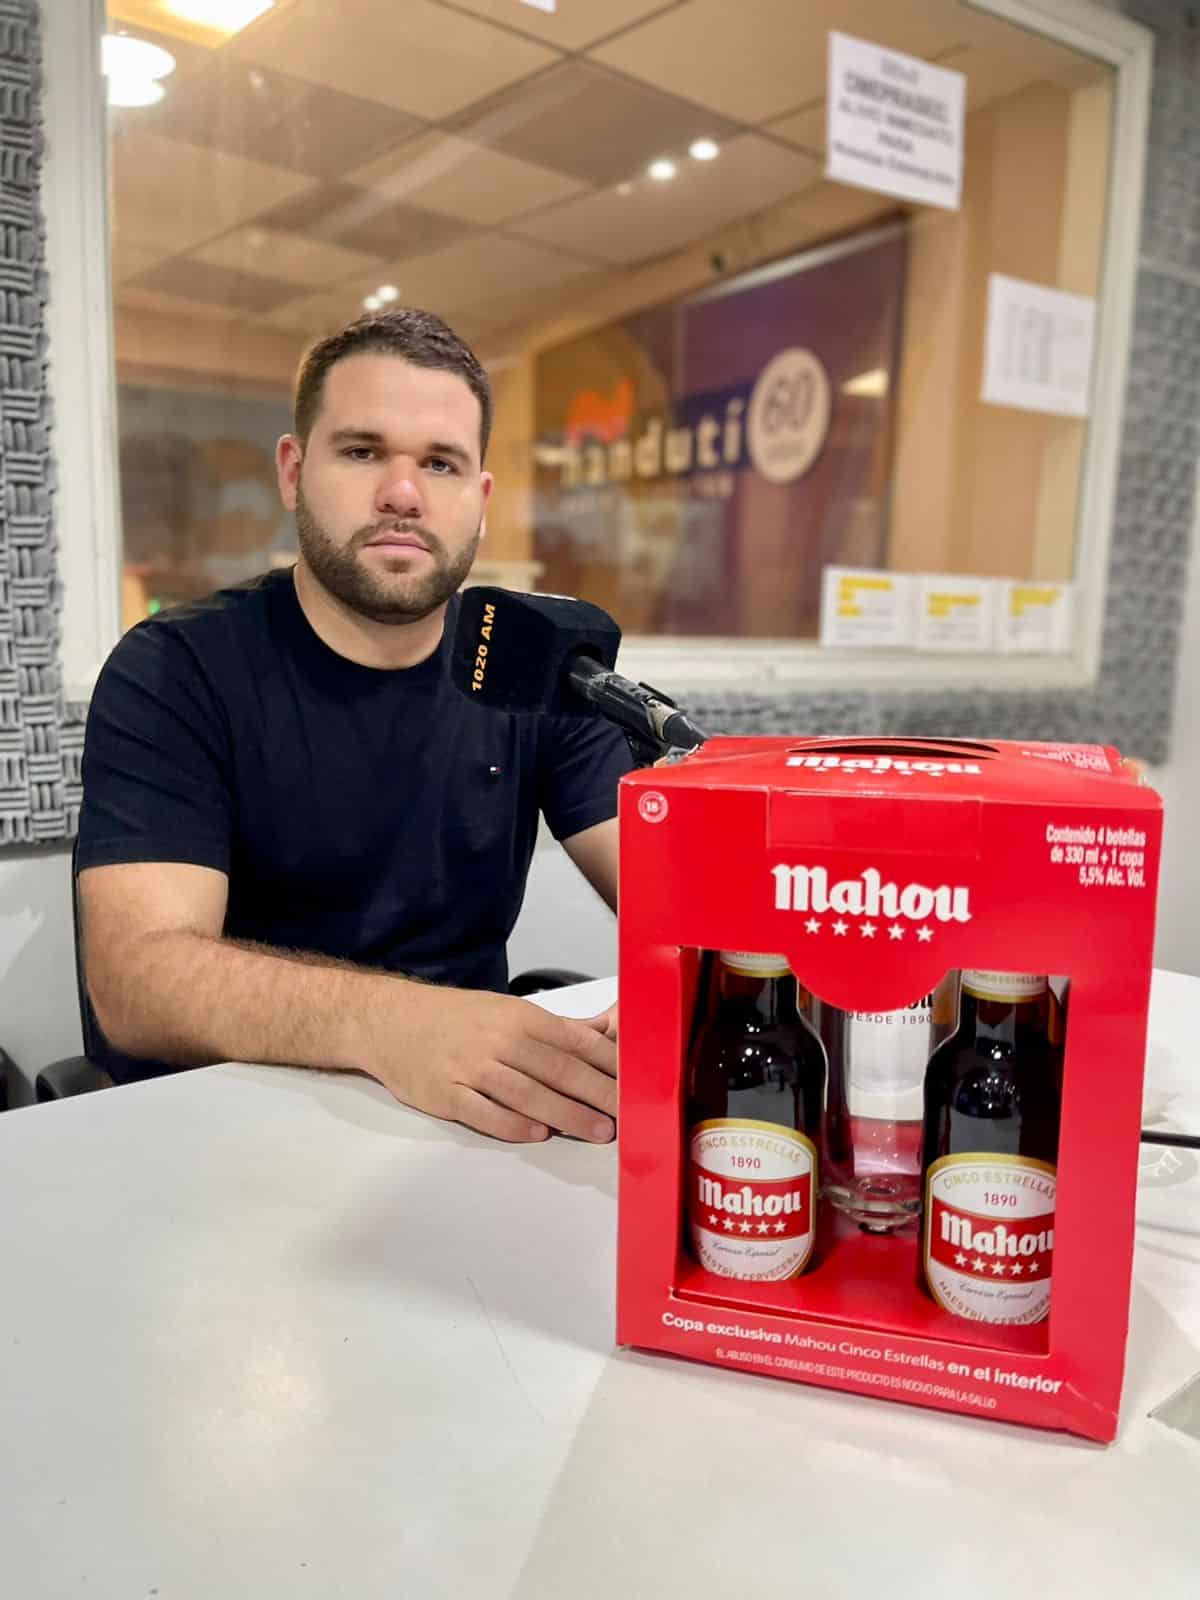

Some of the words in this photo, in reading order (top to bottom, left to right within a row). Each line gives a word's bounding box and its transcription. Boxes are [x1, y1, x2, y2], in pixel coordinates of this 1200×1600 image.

[472, 644, 488, 692] 1020
[480, 603, 497, 641] AM
[1046, 824, 1096, 845] Contenido
[1097, 826, 1105, 846] 4
[1106, 827, 1146, 848] botellas
[1051, 846, 1064, 864] de
[1065, 846, 1084, 864] 330
[1086, 847, 1099, 865] ml
[1111, 848, 1118, 866] 1
[1119, 850, 1144, 871] copa
[1079, 866, 1104, 887] 5,5%
[1105, 868, 1125, 887] Alc.
[1127, 868, 1146, 888] Vol.
[731, 1136, 801, 1163] ESTRELLAS
[731, 1156, 761, 1169] 1890
[943, 1172, 979, 1190] CINCO
[984, 1192, 1017, 1208] 1890
[662, 1312, 704, 1332] Copa
[706, 1321, 782, 1344] exclusiva
[784, 1333, 836, 1352] Mahou
[839, 1342, 881, 1359] Cinco
[884, 1349, 944, 1370] Estrellas
[947, 1362, 969, 1377] en
[974, 1366, 990, 1382] el
[994, 1368, 1062, 1394] interior
[847, 1369, 890, 1387] PRODUCTO
